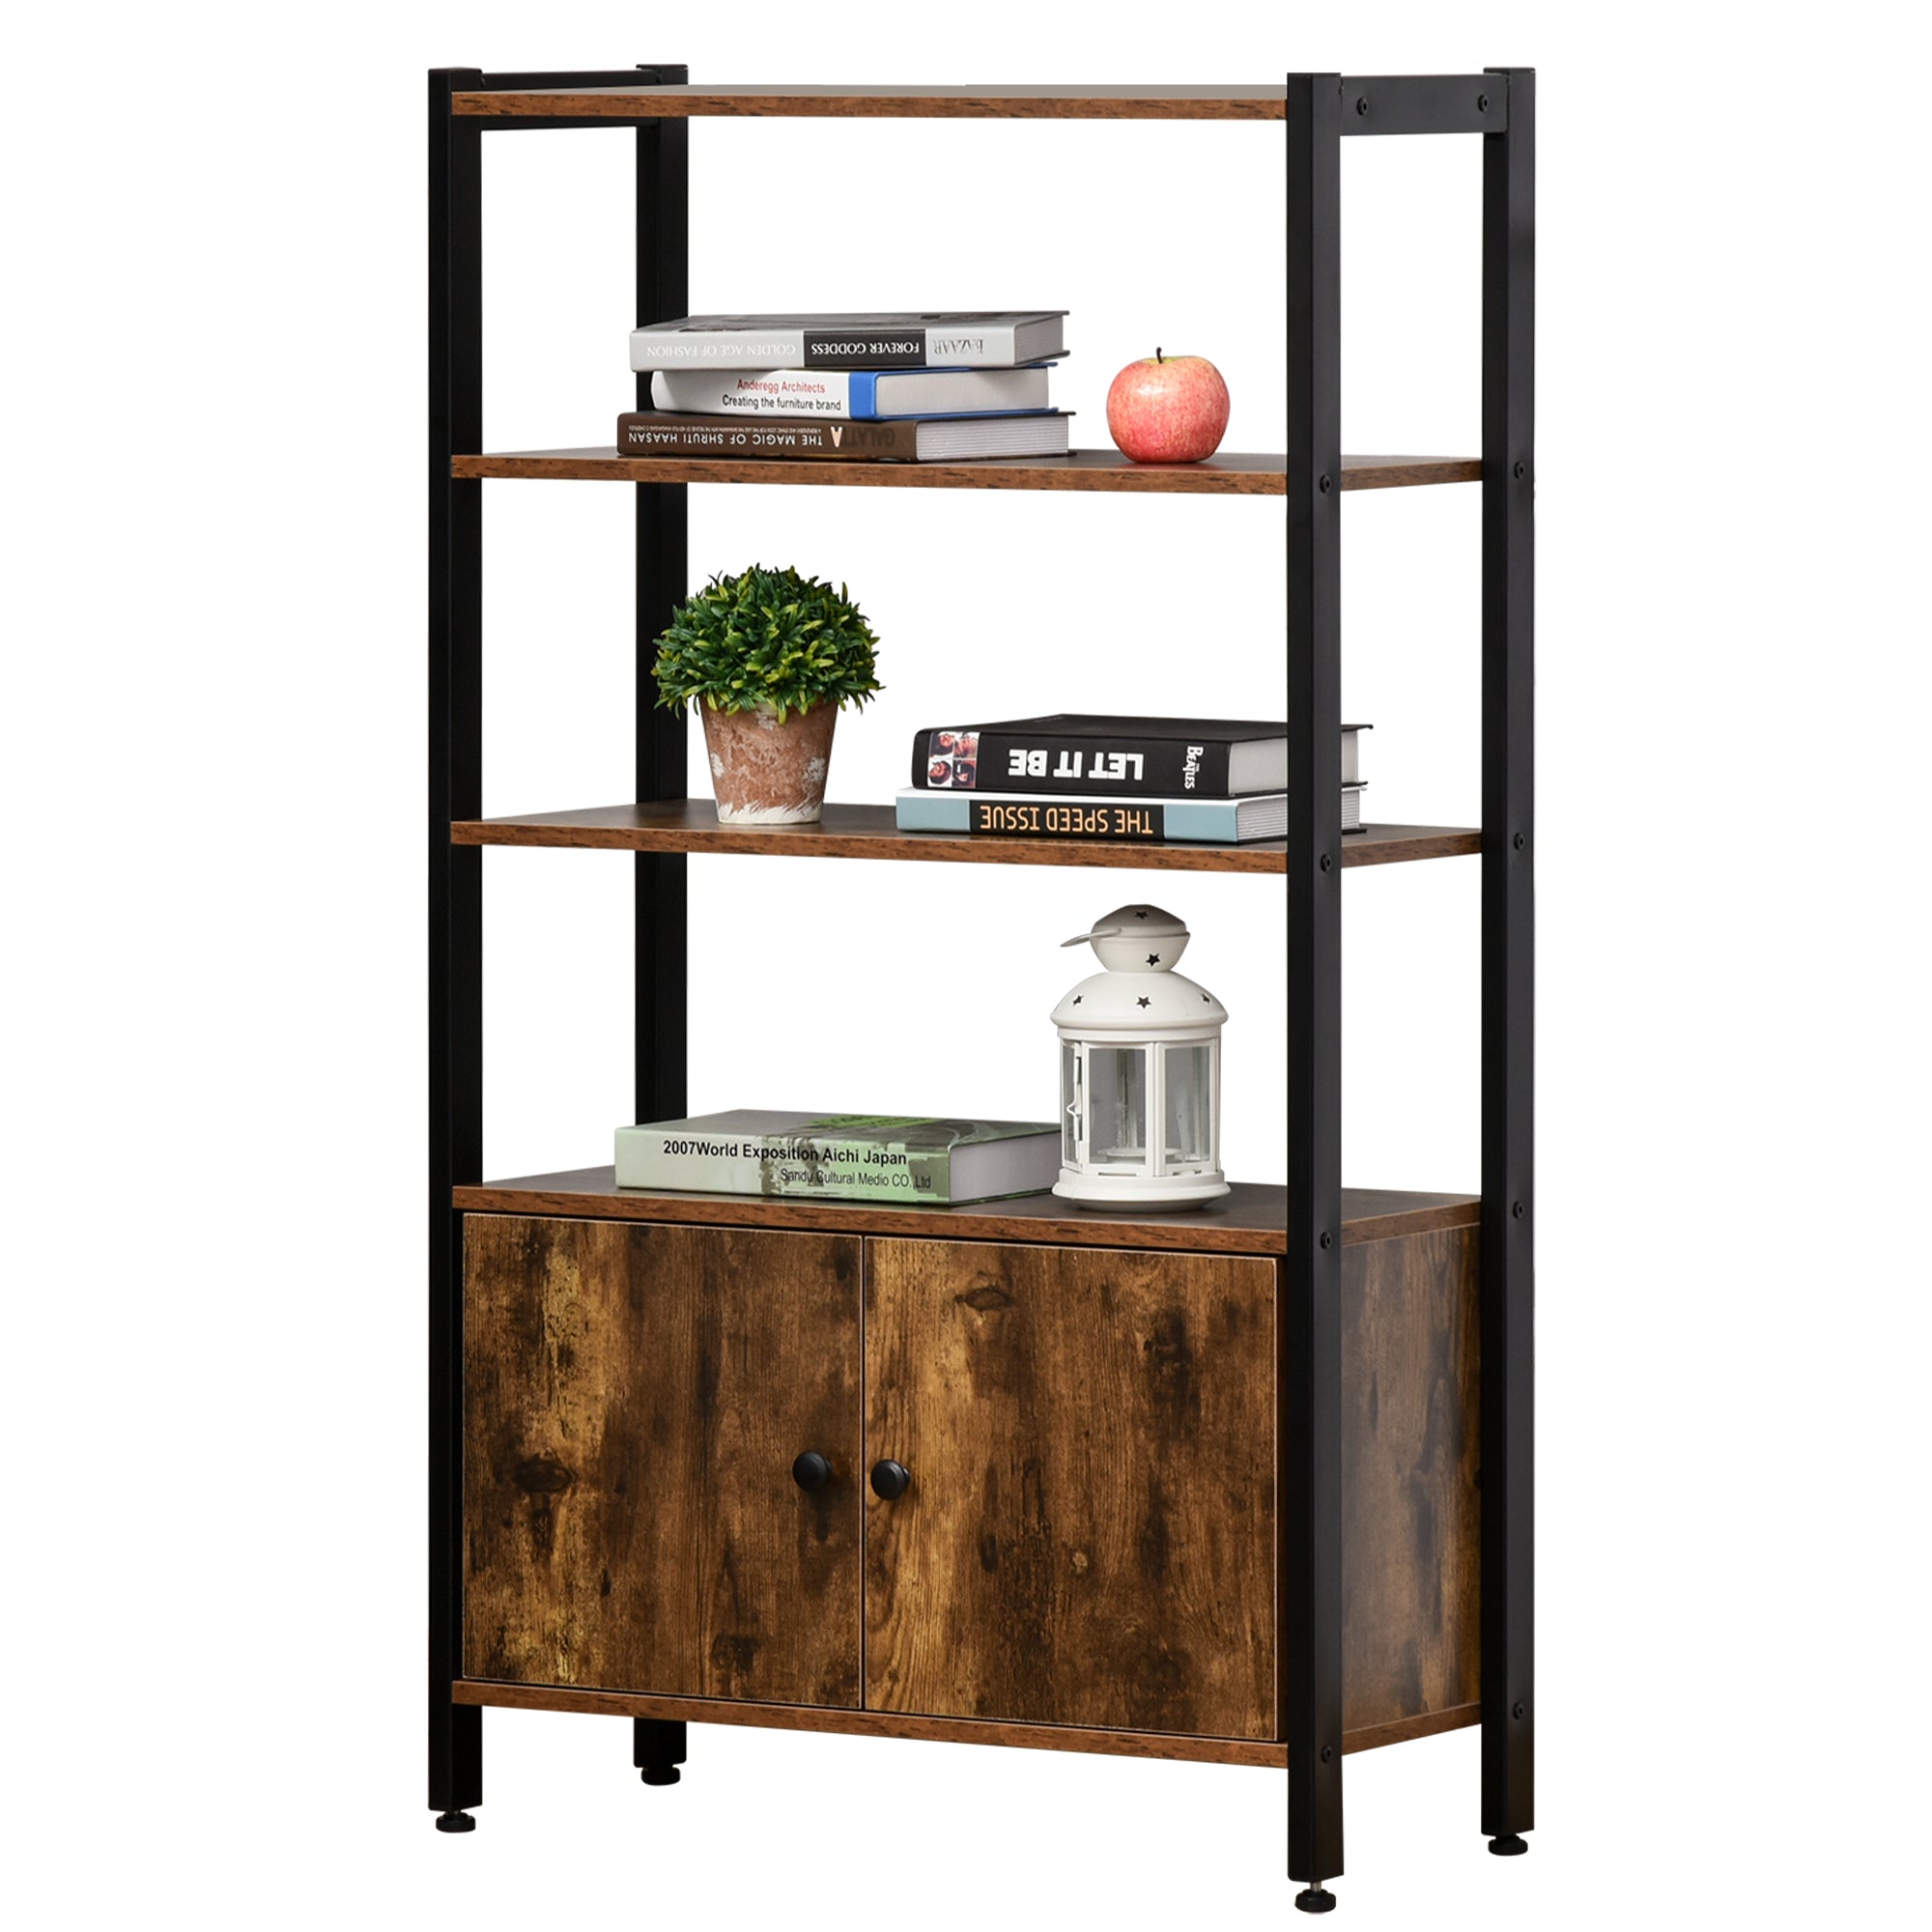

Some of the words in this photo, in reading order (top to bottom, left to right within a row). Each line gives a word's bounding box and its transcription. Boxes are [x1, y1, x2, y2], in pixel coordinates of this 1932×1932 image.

[647, 346, 697, 357] FASHION
[702, 345, 717, 356] OF
[721, 344, 743, 356] AGE
[747, 344, 796, 356] GOLDEN
[810, 342, 867, 355] GODDESS
[869, 342, 920, 355] FOREVER
[737, 379, 779, 394] Anderegg
[781, 381, 826, 394] Architects
[722, 394, 758, 411] Creating
[761, 396, 775, 408] the
[777, 397, 813, 411] furniture
[815, 399, 841, 412] brand
[628, 432, 678, 444] HAASAN
[682, 433, 724, 444] SHRUTI
[729, 434, 747, 445] OF
[752, 434, 796, 445] MAGIC
[802, 435, 823, 446] THE
[1008, 749, 1048, 778] BE
[1053, 751, 1083, 779] IT
[1088, 752, 1145, 781] LET
[980, 805, 1040, 832] ISSUE
[1045, 808, 1109, 834] SPEED
[1114, 810, 1154, 835] THE
[663, 1140, 738, 1157] 2007World
[743, 1144, 819, 1163] Exposition
[822, 1148, 859, 1163] Aichi
[863, 1150, 907, 1167] Japan
[781, 1168, 813, 1184] Sandu
[815, 1170, 855, 1185] Cultural
